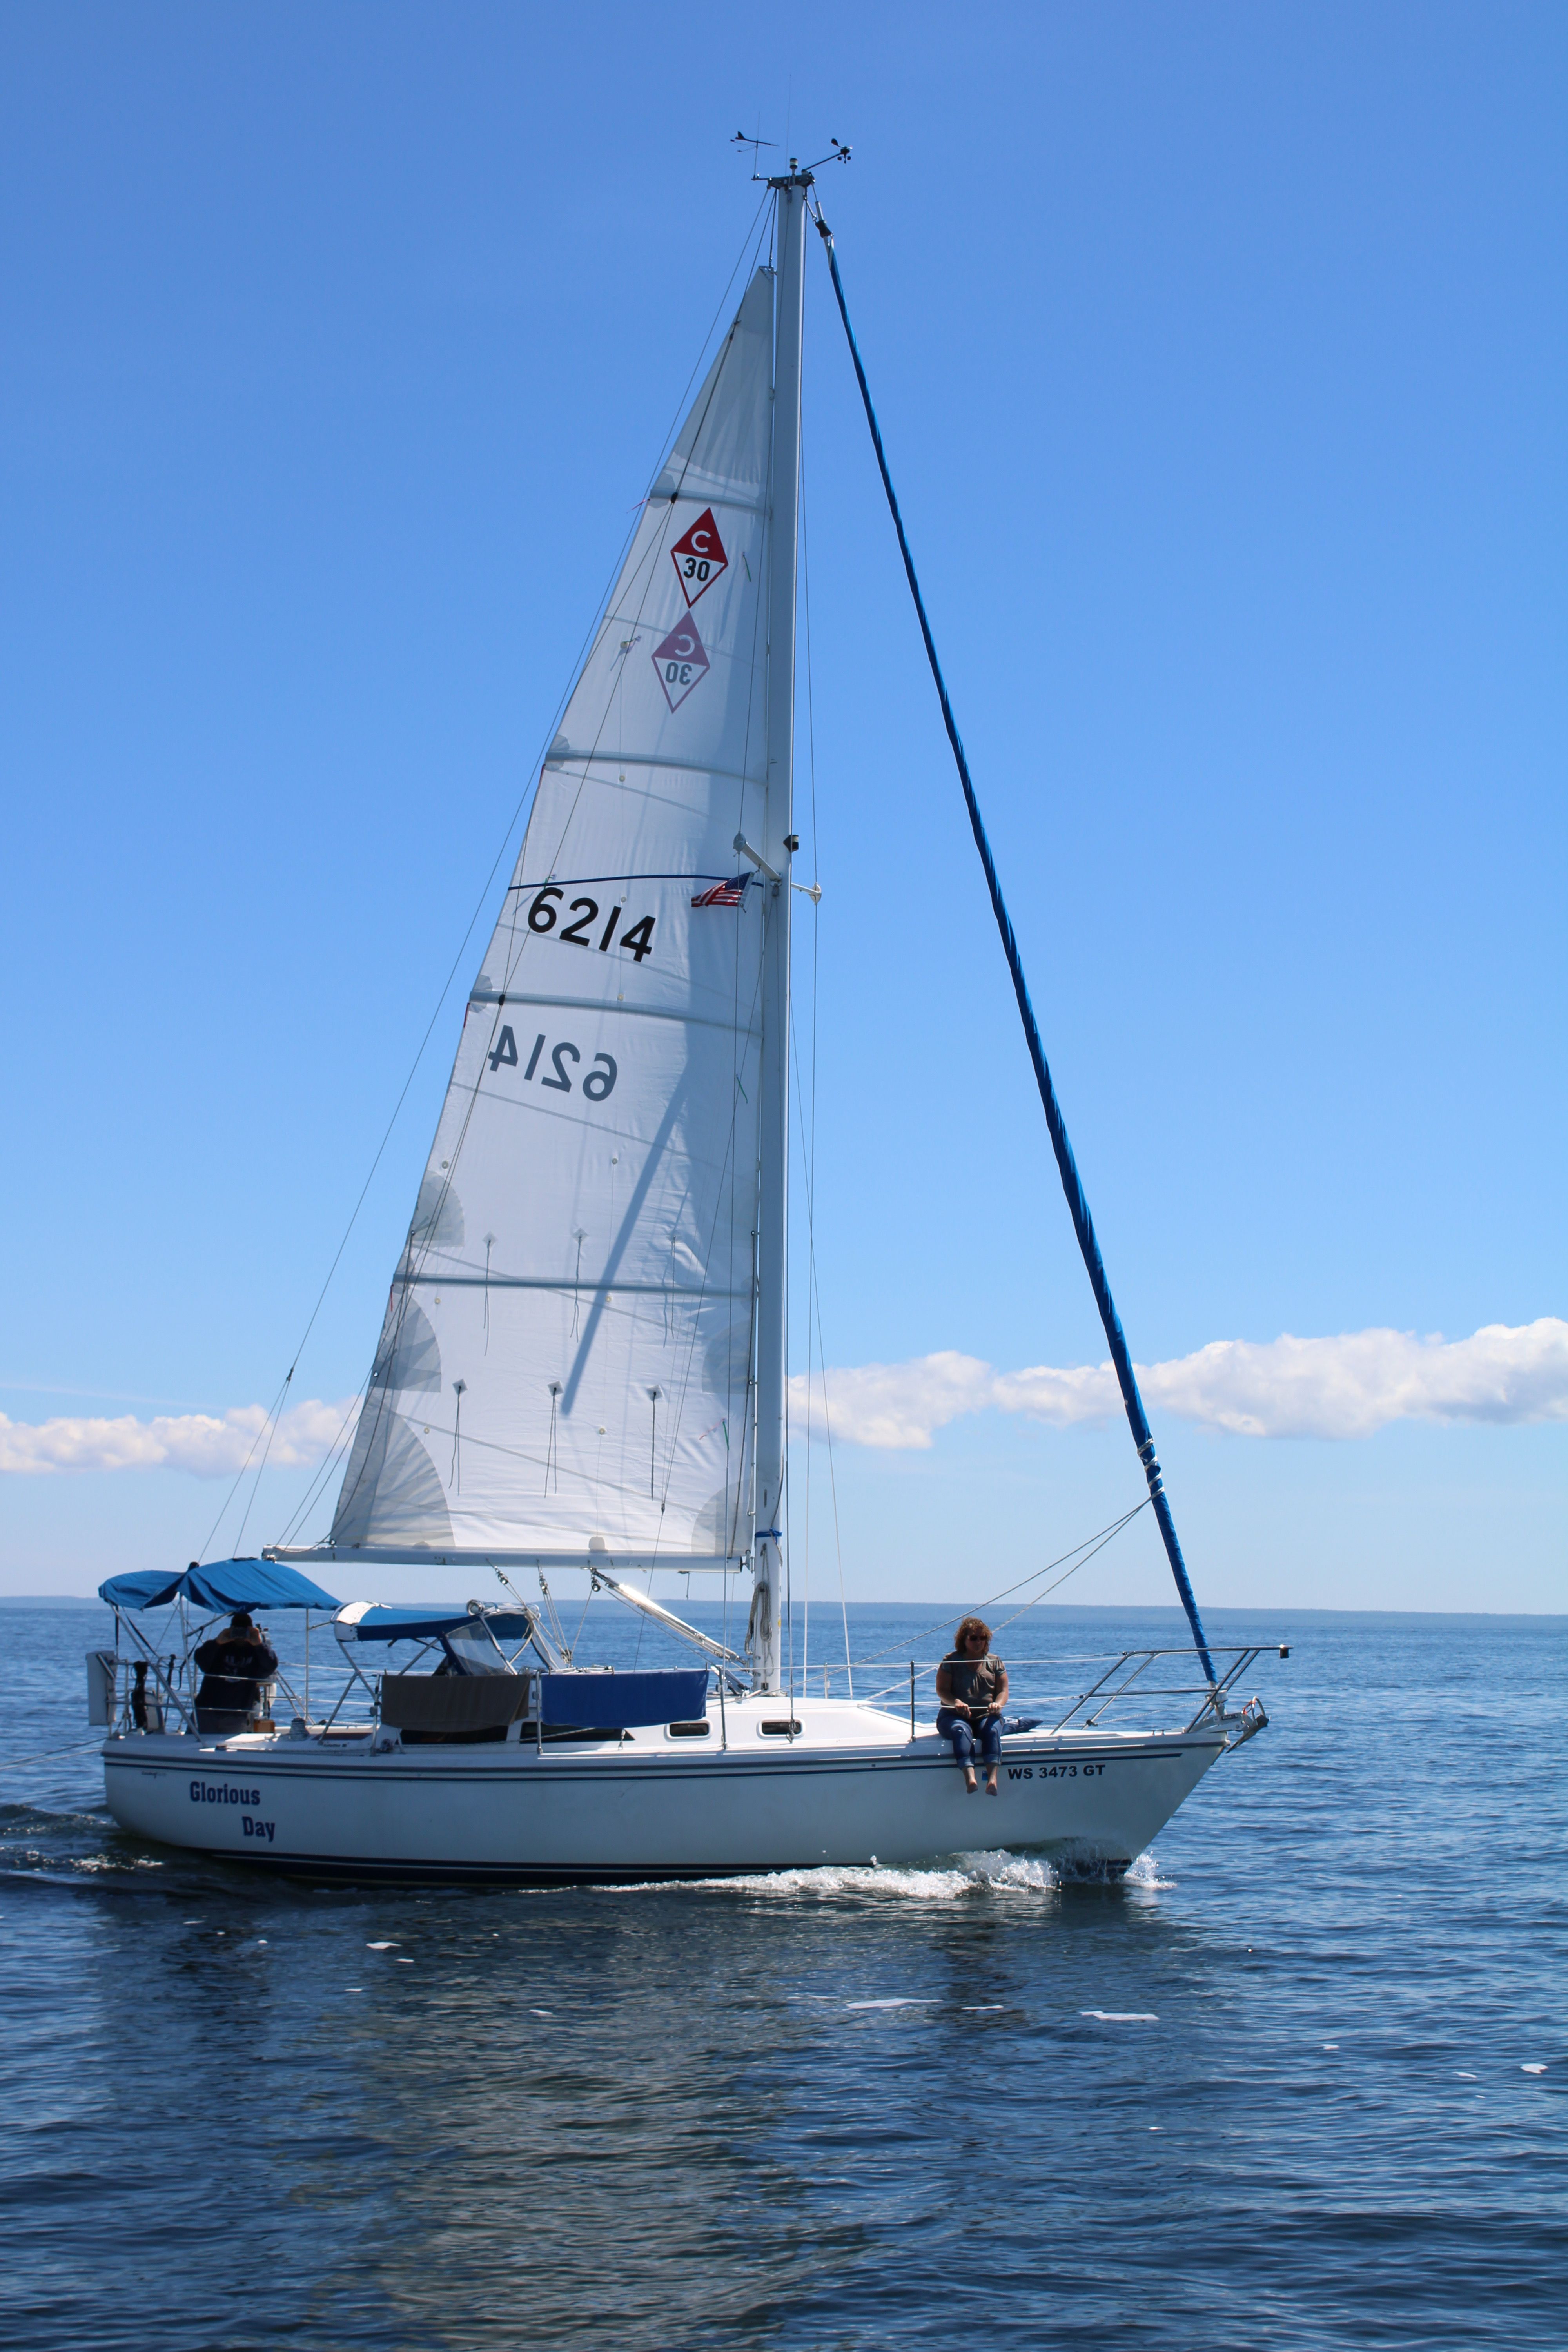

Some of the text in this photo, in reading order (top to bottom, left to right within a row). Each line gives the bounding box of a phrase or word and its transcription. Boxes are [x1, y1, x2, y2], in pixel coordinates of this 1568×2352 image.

[691, 530, 711, 553] C
[683, 557, 710, 582] 30
[528, 887, 656, 962] 6214
[1007, 1764, 1106, 1780] WS 3473 GT
[189, 1781, 261, 1806] Glorious
[241, 1816, 275, 1843] Day
